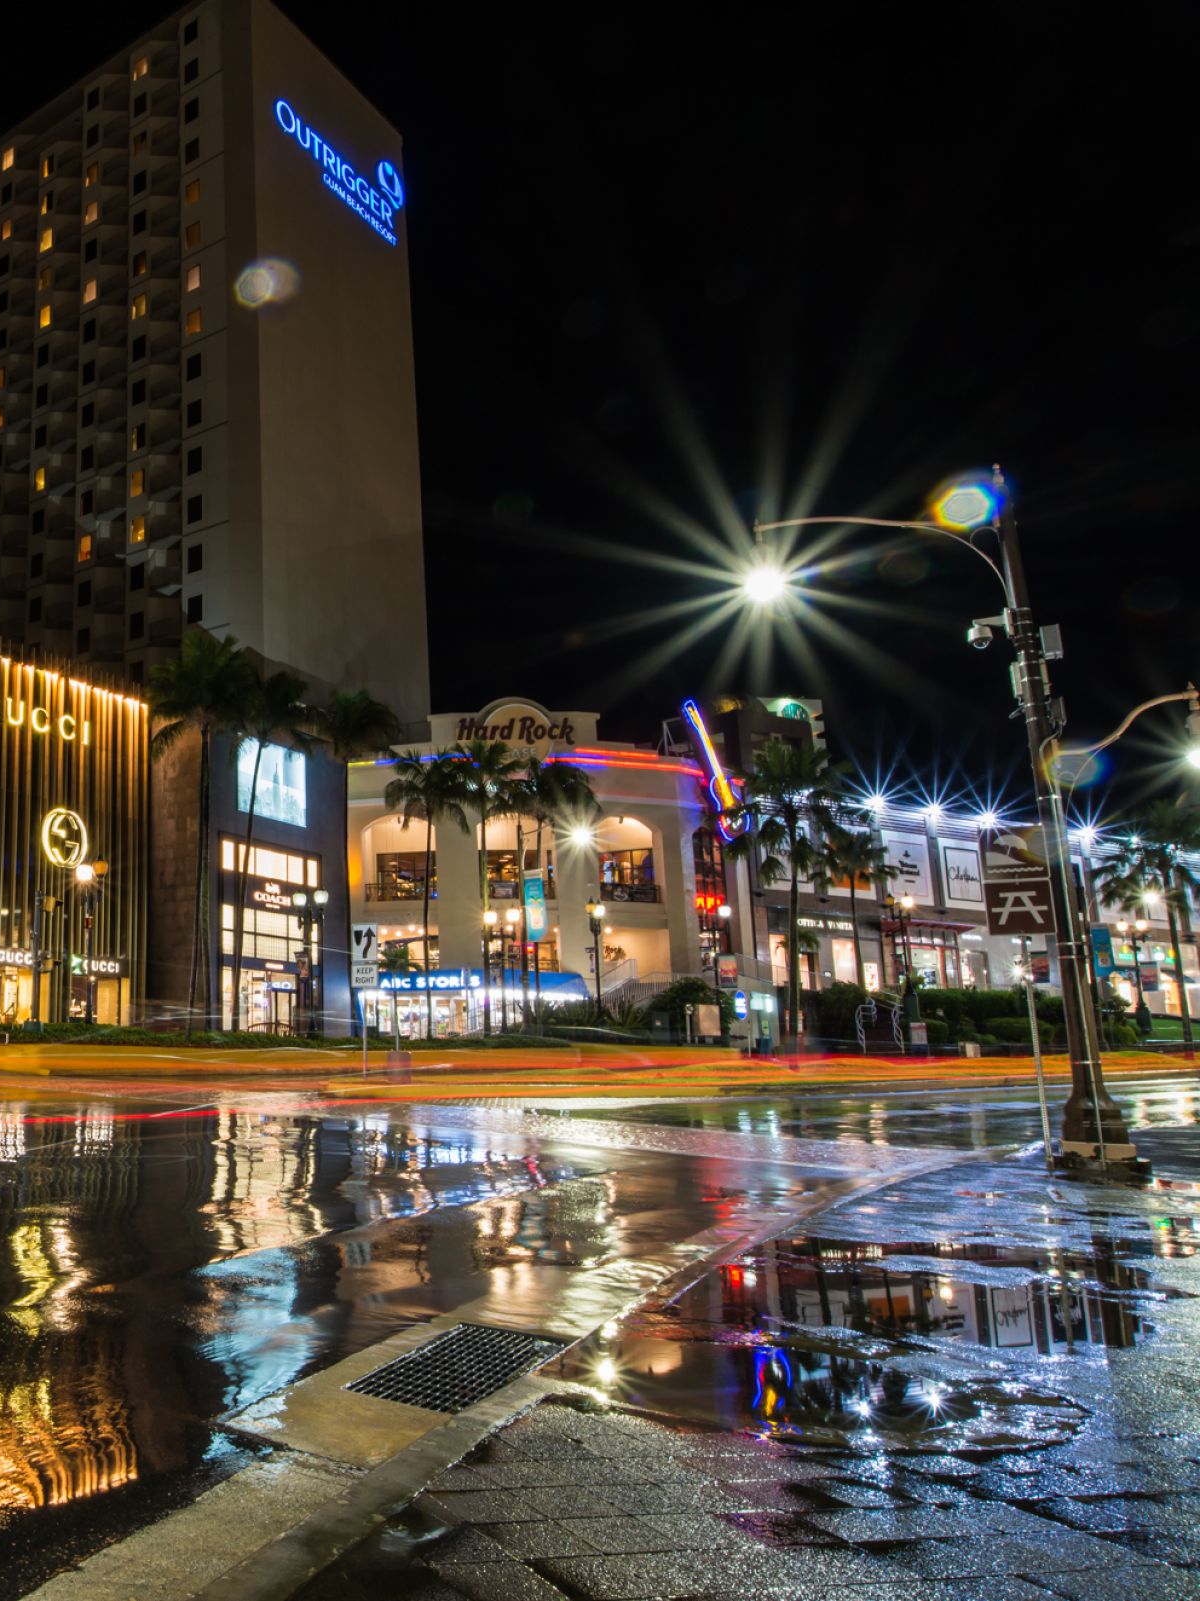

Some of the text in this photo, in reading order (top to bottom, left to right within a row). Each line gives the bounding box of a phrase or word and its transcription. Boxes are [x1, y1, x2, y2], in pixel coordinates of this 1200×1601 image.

[276, 100, 394, 229] OUTRIGGER
[322, 173, 398, 247] GUAM BEACH RESORT
[457, 716, 575, 745] Hard Rock
[253, 891, 292, 907] COACH
[356, 967, 374, 975] KEEP
[355, 976, 375, 984] RIGHT
[416, 975, 481, 989] STORS
